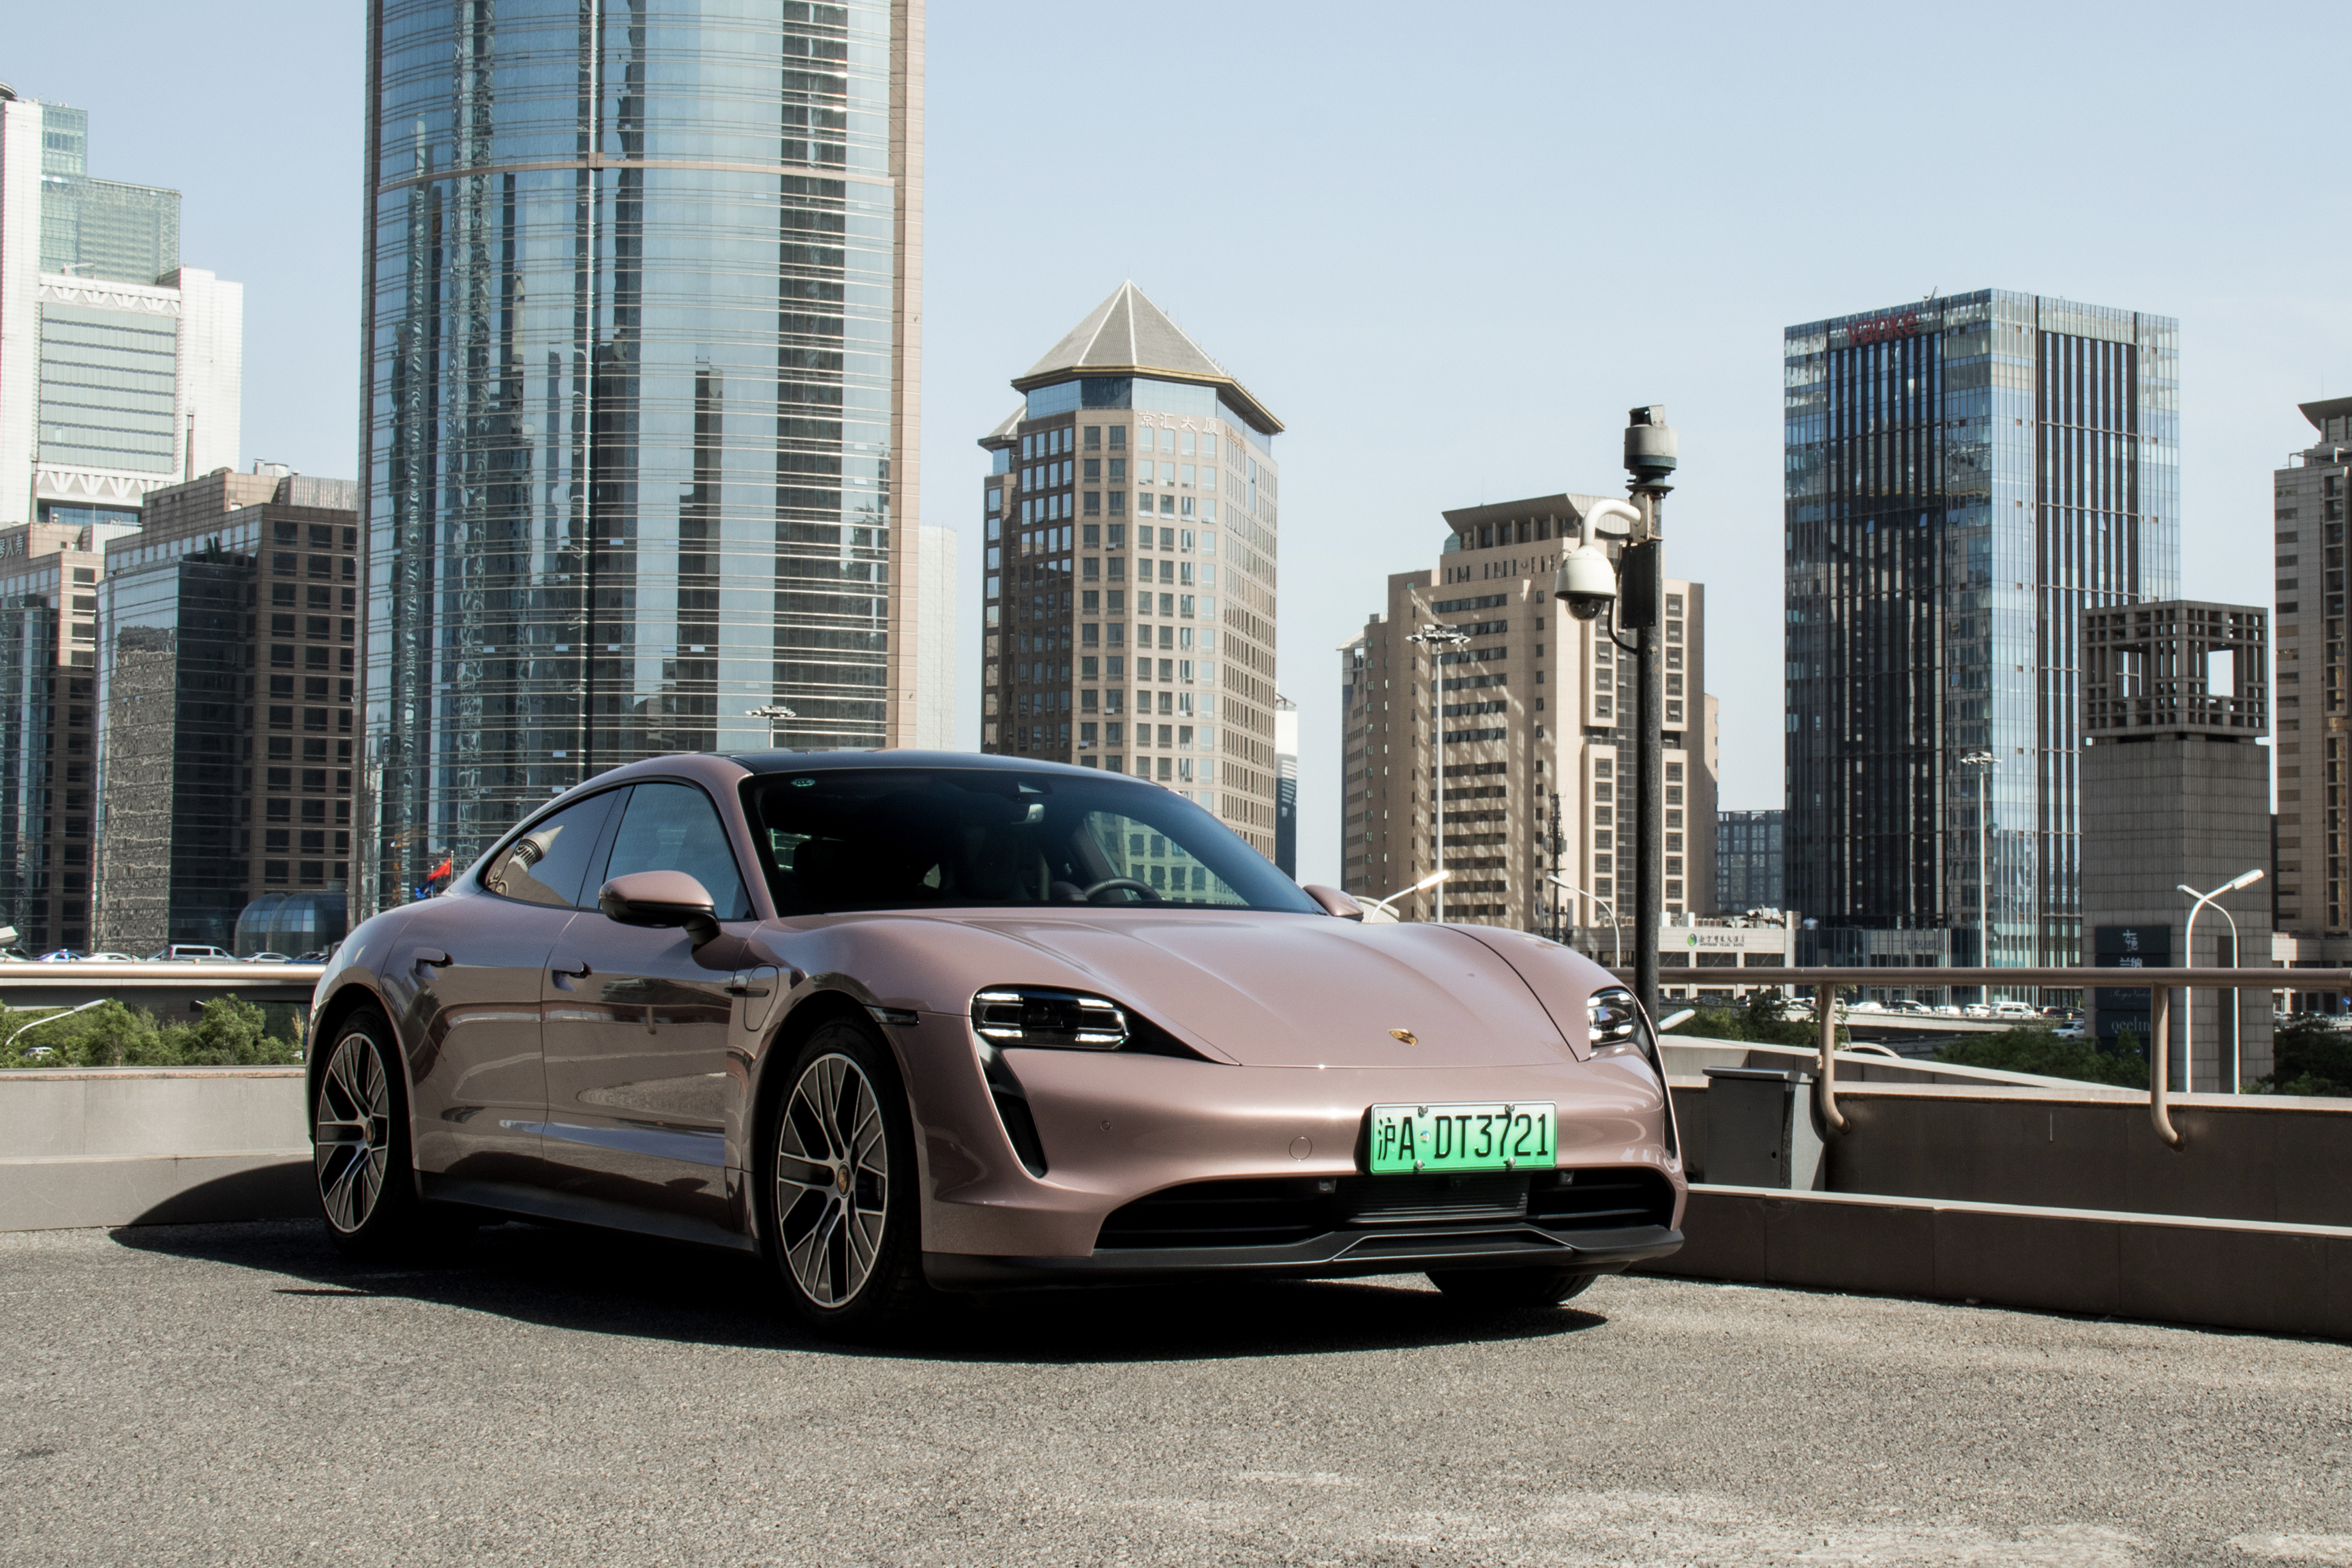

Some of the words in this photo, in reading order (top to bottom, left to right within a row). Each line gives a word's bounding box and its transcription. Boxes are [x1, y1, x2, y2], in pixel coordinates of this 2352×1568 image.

[1846, 312, 1917, 346] vanke
[1138, 410, 1220, 436] 京汇大厦
[1377, 1116, 1415, 1160] 沪A
[1434, 1113, 1549, 1159] DT3721
